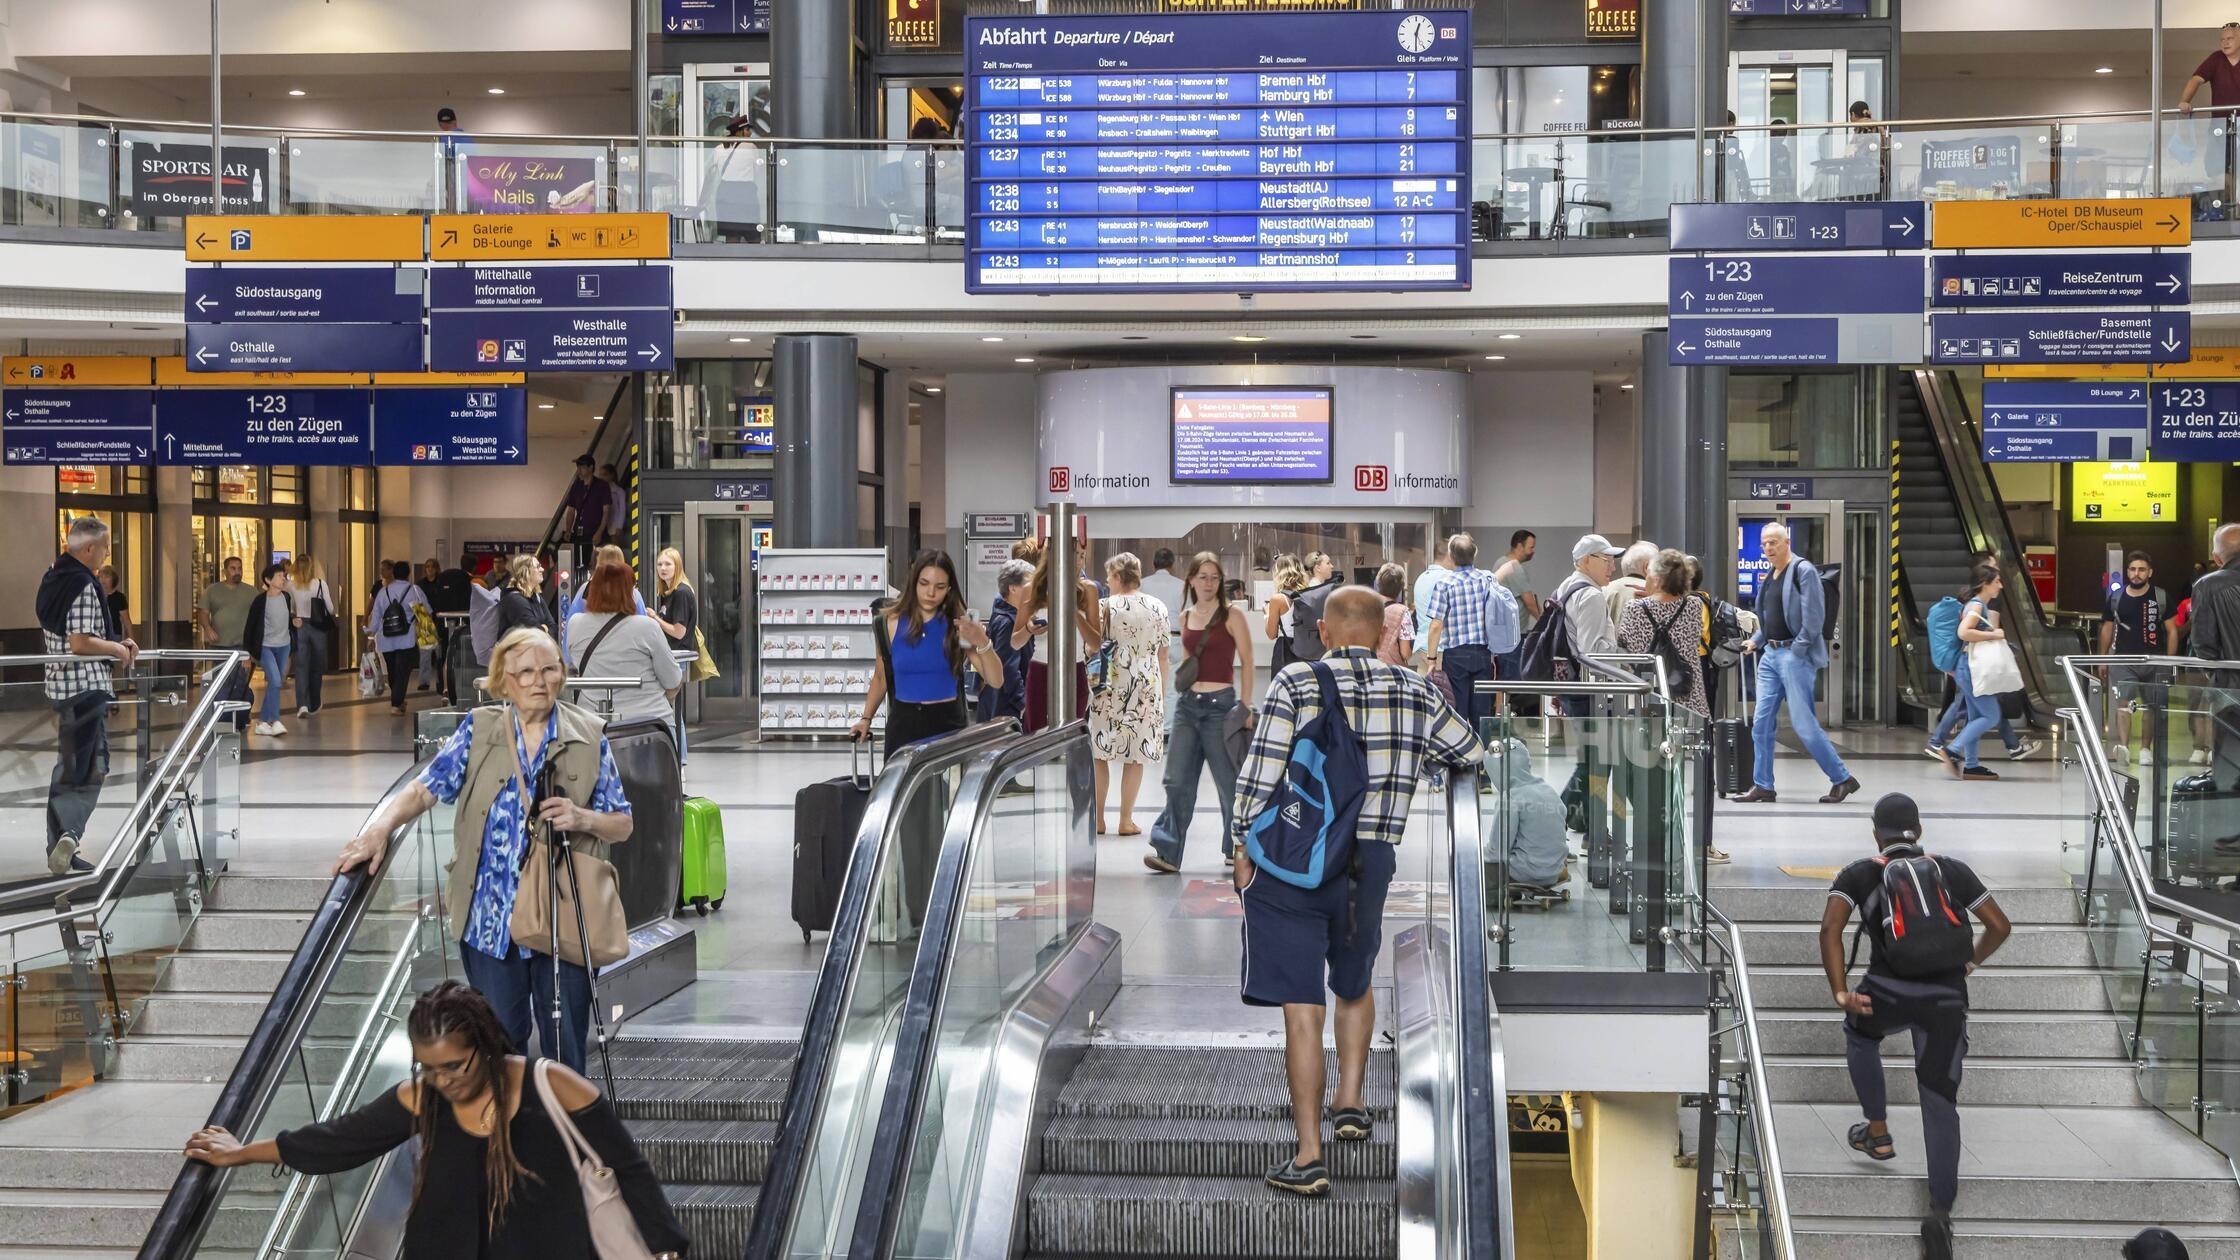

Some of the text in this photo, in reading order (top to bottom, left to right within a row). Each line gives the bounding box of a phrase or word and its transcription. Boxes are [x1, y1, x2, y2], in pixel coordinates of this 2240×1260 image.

[1590, 10, 1636, 25] COFFEE
[890, 21, 934, 36] COFFEE
[980, 28, 1174, 46] Abfahrt Departure Départ
[983, 61, 996, 69] Zeit
[1098, 58, 1115, 67] Über
[988, 78, 1018, 90] 12:22
[1098, 80, 1131, 88] Würzburg
[1260, 75, 1326, 86] Bremen Hbf
[1408, 74, 1414, 84] 7
[1098, 94, 1131, 102] Würzburg
[1260, 90, 1332, 103] Hamburg Hbf
[1408, 88, 1414, 98] 7
[988, 114, 1018, 125] 12:31
[1276, 111, 1304, 122] Wien
[1408, 110, 1414, 120] 9
[1260, 125, 1334, 138] Stuttgart Hbf
[1400, 124, 1414, 135] 18
[1544, 122, 1572, 132] COFFEE
[988, 128, 1018, 139] 12:34
[1180, 129, 1218, 137] Waiblingen
[988, 150, 1018, 160] 12:37
[1202, 150, 1250, 158] Marktredwitz
[1260, 147, 1302, 158] Hof Hbf
[1400, 146, 1413, 156] 21
[1934, 150, 1970, 161] COFFEE
[142, 160, 248, 176] SPORTSAR
[1260, 162, 1334, 174] Bayreuth Hbf
[1400, 160, 1413, 170] 21
[1934, 160, 1970, 168] FELLOWS
[479, 162, 564, 186] My Linh
[989, 186, 1018, 196] 12:38
[1154, 186, 1194, 194] Siegelsdorf
[1260, 182, 1328, 193] Neustadt(A.)
[144, 192, 248, 205] im Obergeshoss
[494, 190, 534, 204] Nails
[1394, 196, 1432, 206] 12 A-C
[989, 200, 1018, 210] 12:40
[1260, 196, 1371, 210] Allersberg(Rothsee)
[2022, 207, 2142, 217] IC-Hotel DB Museum
[989, 221, 1018, 232] 12:43
[1260, 218, 1374, 229] Neustadt(Waldnaab)
[1401, 217, 1414, 228] 17
[2048, 220, 2142, 232] Oper/Schauspiel
[474, 224, 513, 234] Galerie
[1810, 227, 1838, 238] 1-23
[1260, 232, 1348, 246] Regensburg Hbf
[1401, 232, 1414, 242] 17
[474, 238, 532, 249] DB-Lounge
[989, 256, 1018, 267] 12:43
[1260, 254, 1339, 264] Hartmannshof
[1407, 253, 1414, 263] 2
[475, 270, 531, 280] Mittelhalle
[1706, 262, 1751, 281] 1-23
[2064, 273, 2142, 283] ReiseZentrum
[236, 287, 322, 300] Südostausgang
[475, 284, 535, 295] Information
[1736, 292, 1763, 302] Zügen
[574, 320, 626, 330] Westhalle
[2101, 319, 2151, 327] Basement
[1705, 328, 1772, 338] Südostausgang
[2029, 330, 2151, 340] Schließfächer/Fundstelle
[554, 336, 626, 346] Reisezentrum
[230, 342, 274, 352] Osthalle
[2162, 389, 2205, 407] 1-23
[24, 400, 70, 408] Südostausgang
[247, 396, 286, 413] 1-23
[476, 410, 496, 418] Zügen
[2162, 416, 2179, 426] zu
[2186, 412, 2214, 426] den
[247, 418, 342, 434] zu den Zügen
[257, 435, 270, 443] the
[298, 434, 320, 443] accès
[339, 436, 358, 444] quais
[452, 436, 497, 445] Südausgang
[1052, 470, 1150, 488] DB Information
[1358, 469, 1457, 488] DB Information
